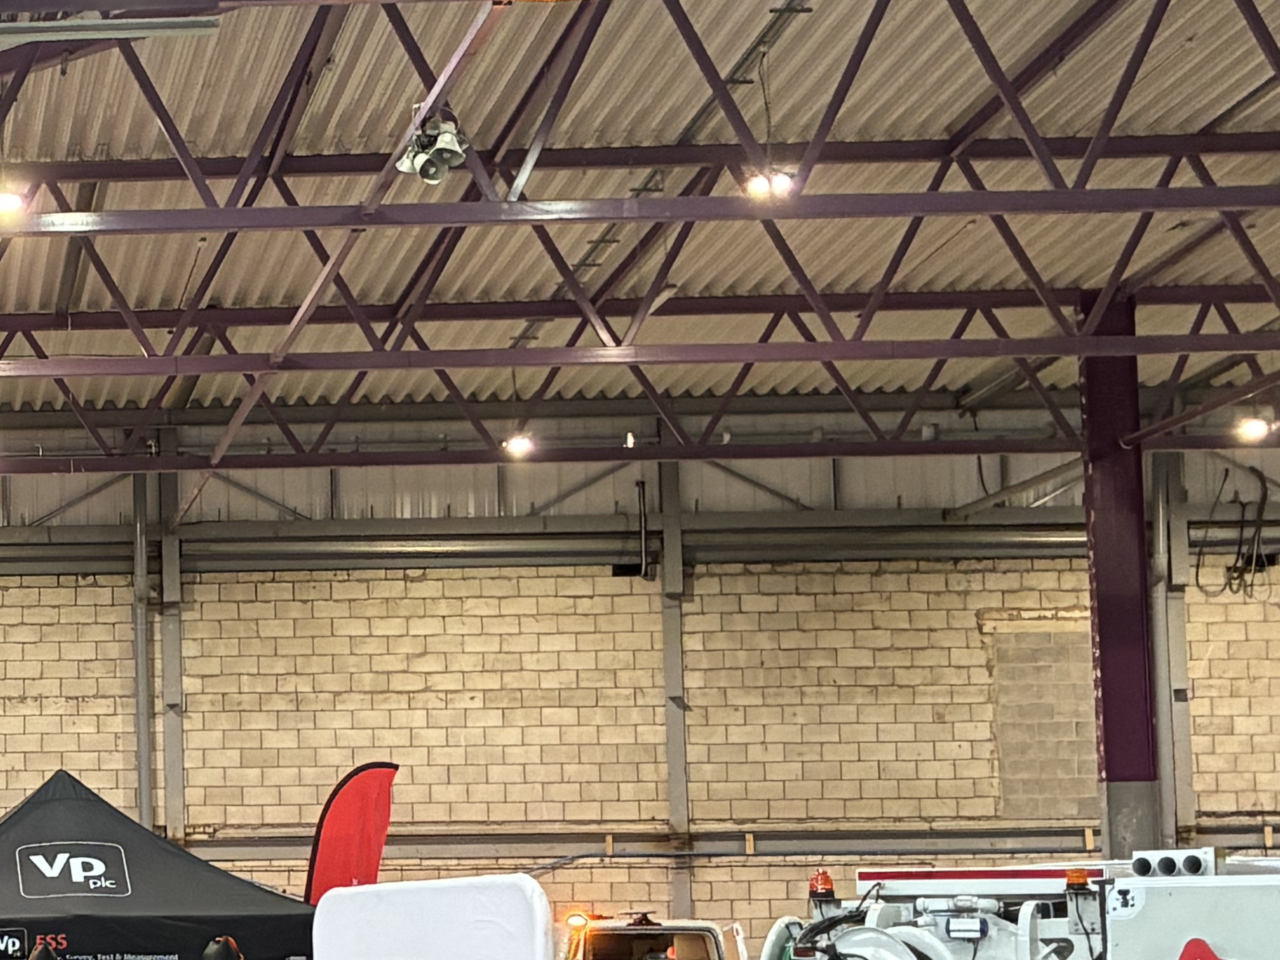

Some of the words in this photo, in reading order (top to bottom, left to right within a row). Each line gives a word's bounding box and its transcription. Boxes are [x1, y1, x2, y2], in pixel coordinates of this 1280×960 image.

[29, 852, 107, 883] Vp
[89, 877, 117, 890] plc
[36, 933, 68, 950] ESS
